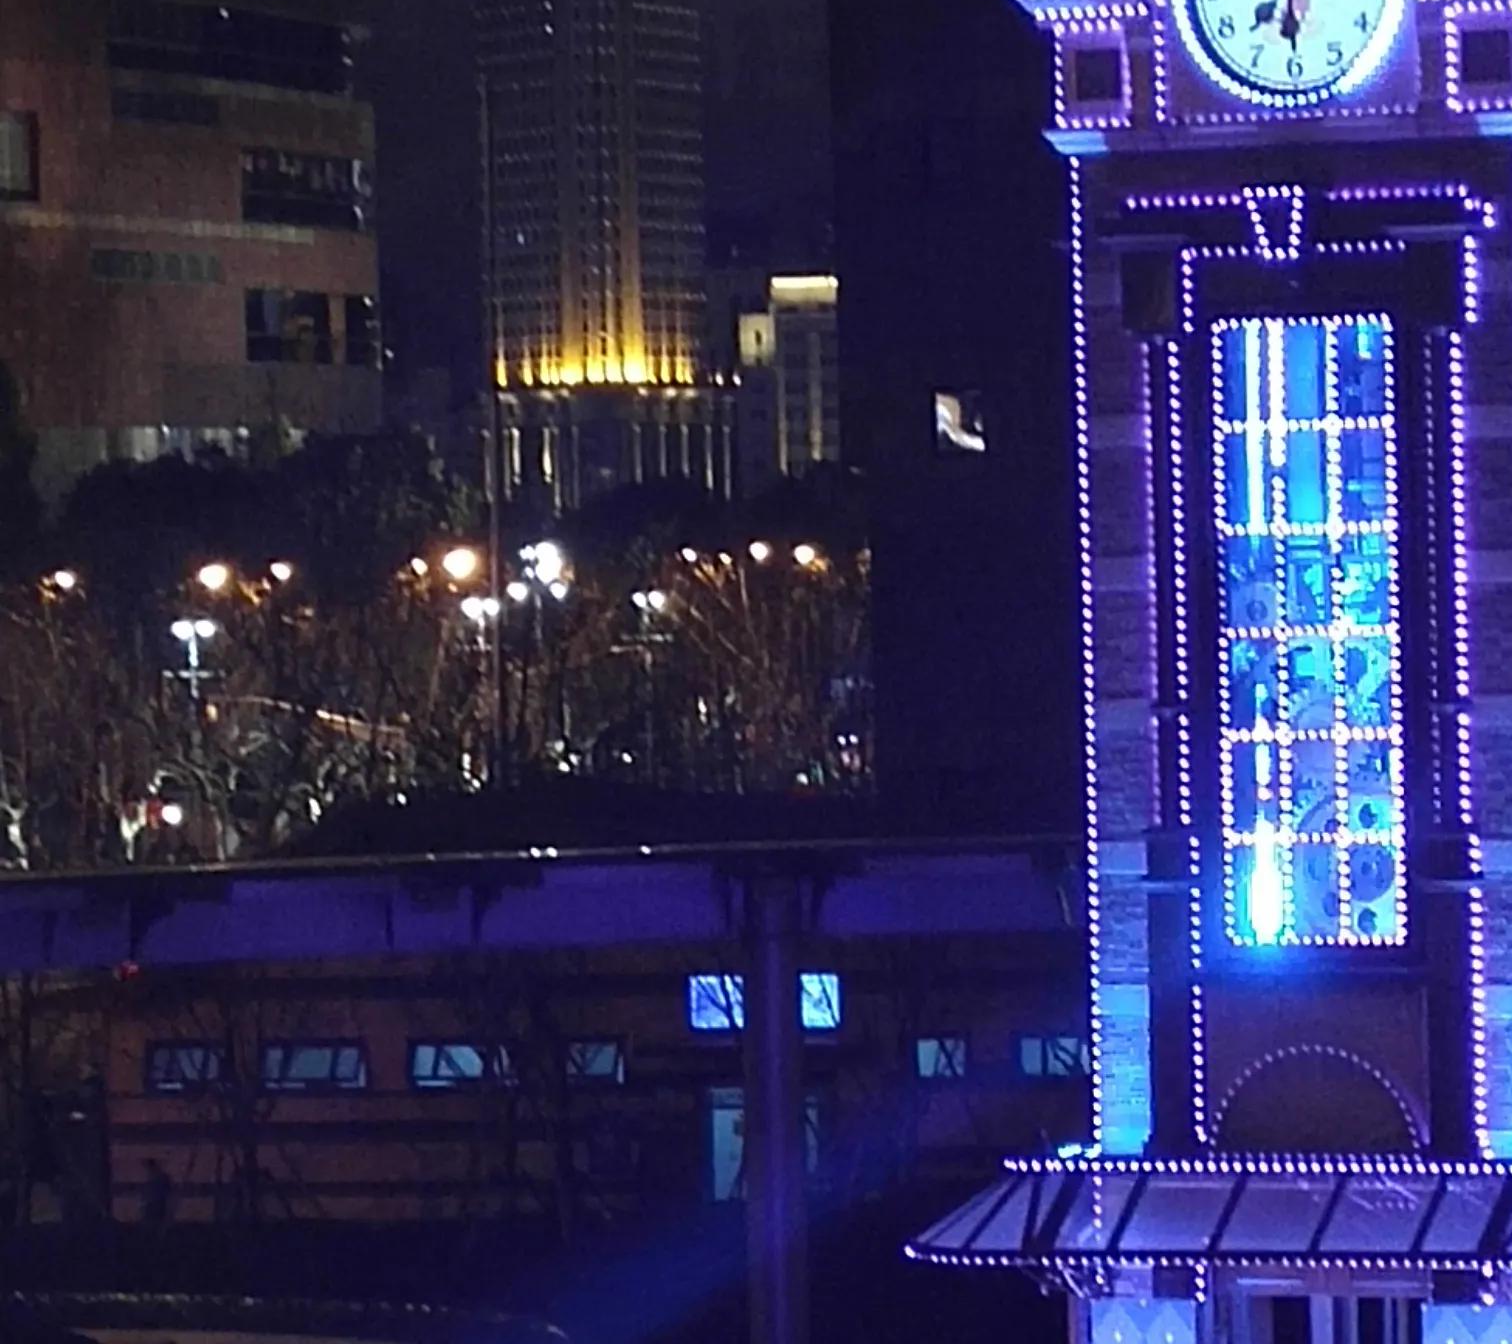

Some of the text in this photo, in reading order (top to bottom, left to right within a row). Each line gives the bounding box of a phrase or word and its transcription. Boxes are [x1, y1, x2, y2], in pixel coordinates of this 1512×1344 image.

[1219, 15, 1235, 38] 8
[1353, 12, 1367, 33] 4
[1250, 44, 1264, 67] 7
[1327, 41, 1342, 66] 5
[1287, 56, 1303, 78] 6
